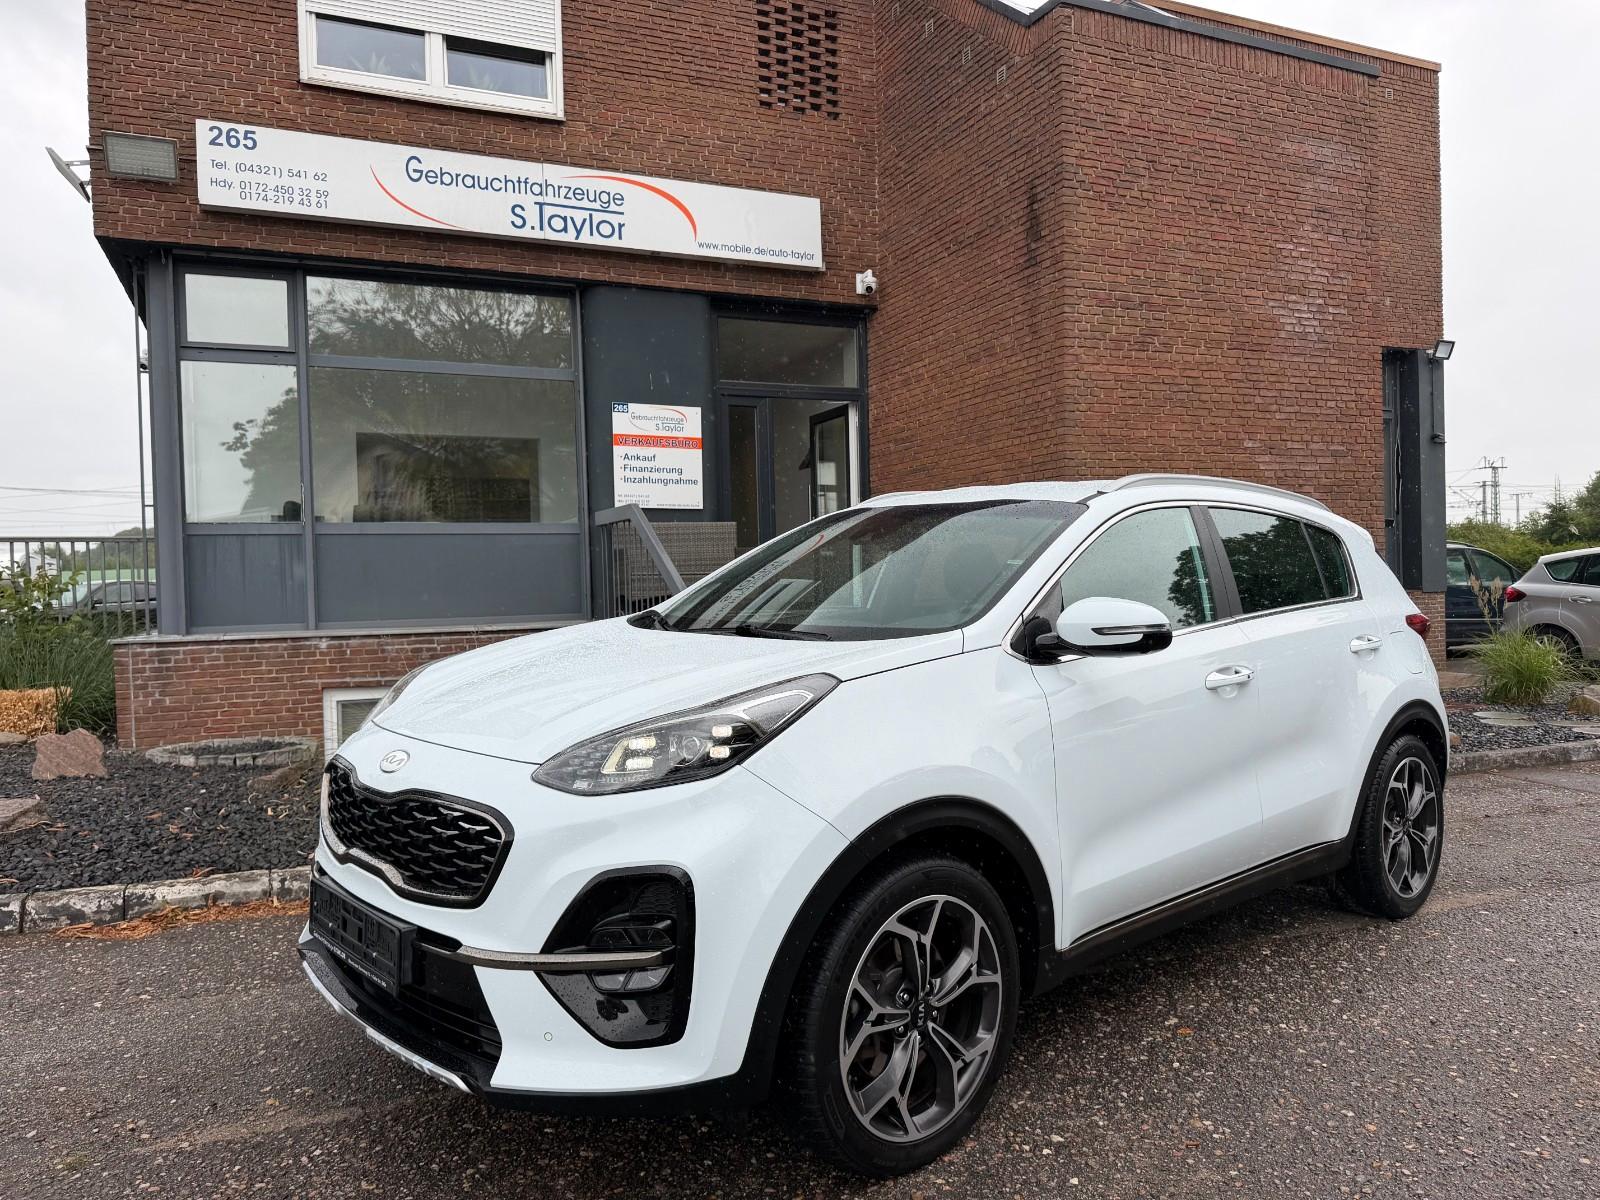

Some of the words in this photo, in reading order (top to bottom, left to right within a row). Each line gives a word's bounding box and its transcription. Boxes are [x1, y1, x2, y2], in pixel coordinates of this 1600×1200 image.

[208, 125, 258, 151] 265
[210, 159, 231, 171] Tel.
[235, 162, 283, 178] (04321)
[287, 168, 308, 179] 541
[313, 171, 328, 182] 62
[210, 177, 236, 191] Hdy.
[239, 180, 294, 196] 0172-450
[298, 187, 312, 198] 32
[315, 189, 329, 200] 59
[405, 155, 625, 209] Gebrauchtfahrzeuge
[239, 190, 294, 205] 0174-219
[298, 197, 312, 208] 43
[315, 199, 329, 209] 61
[510, 202, 625, 241] S.Taylor
[697, 240, 815, 262] www.mobile.de/auto-taylor
[614, 404, 628, 412] 265
[623, 463, 683, 476] Finanzierung
[623, 476, 698, 486] Inzahlungnahme
